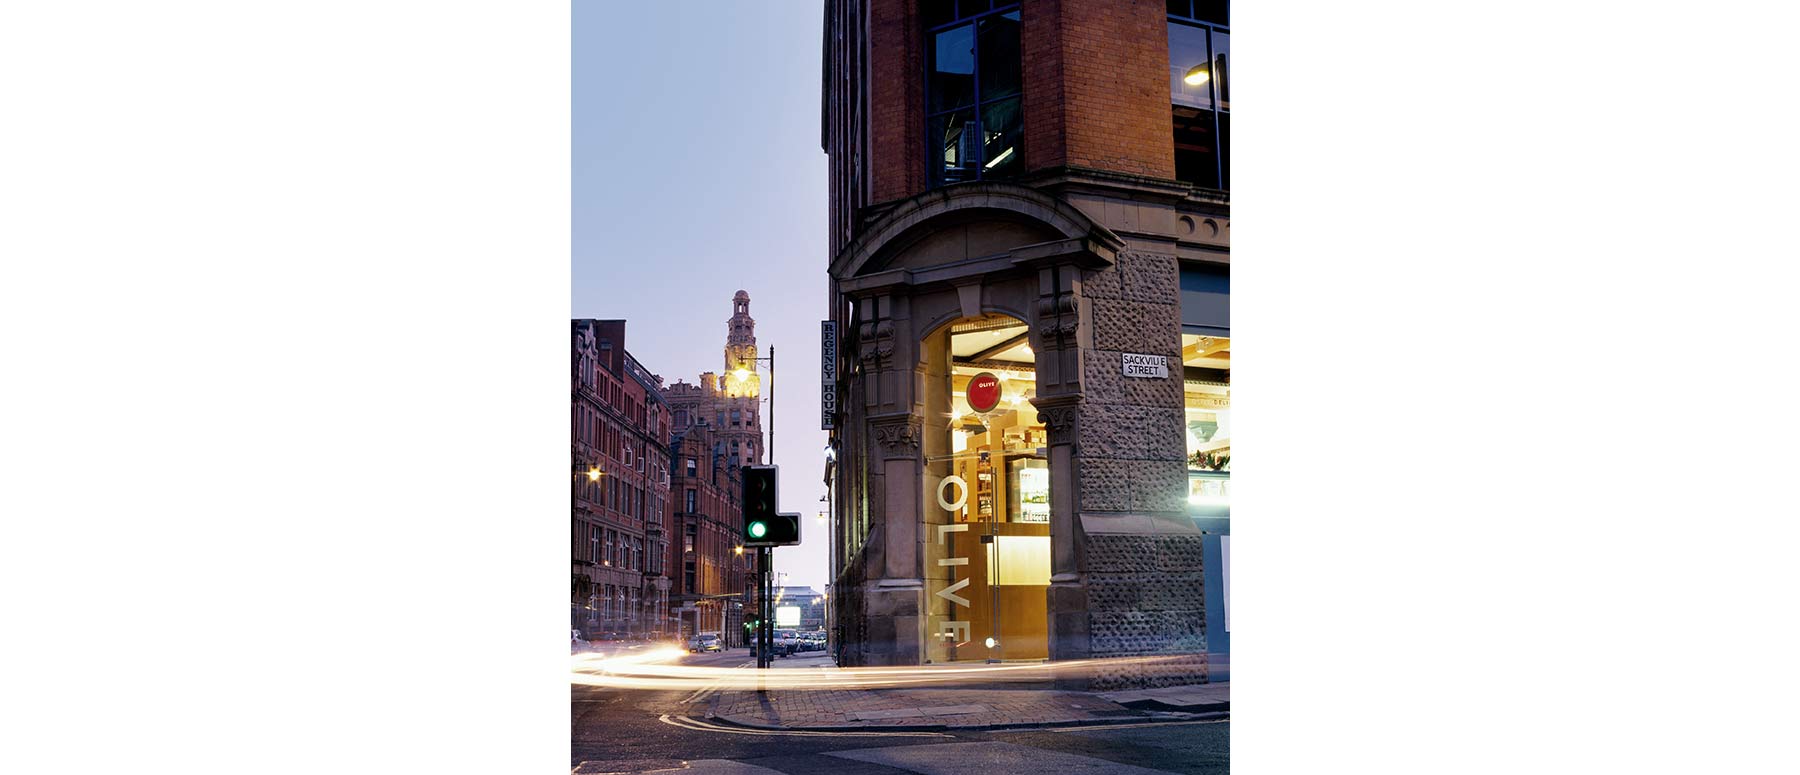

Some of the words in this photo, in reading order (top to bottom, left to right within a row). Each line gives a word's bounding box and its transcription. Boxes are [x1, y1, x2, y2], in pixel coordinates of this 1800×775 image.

[823, 323, 835, 380] REGENCY
[1127, 365, 1159, 375] STREET
[823, 384, 835, 426] HOUSE
[936, 475, 971, 643] OLIVE
